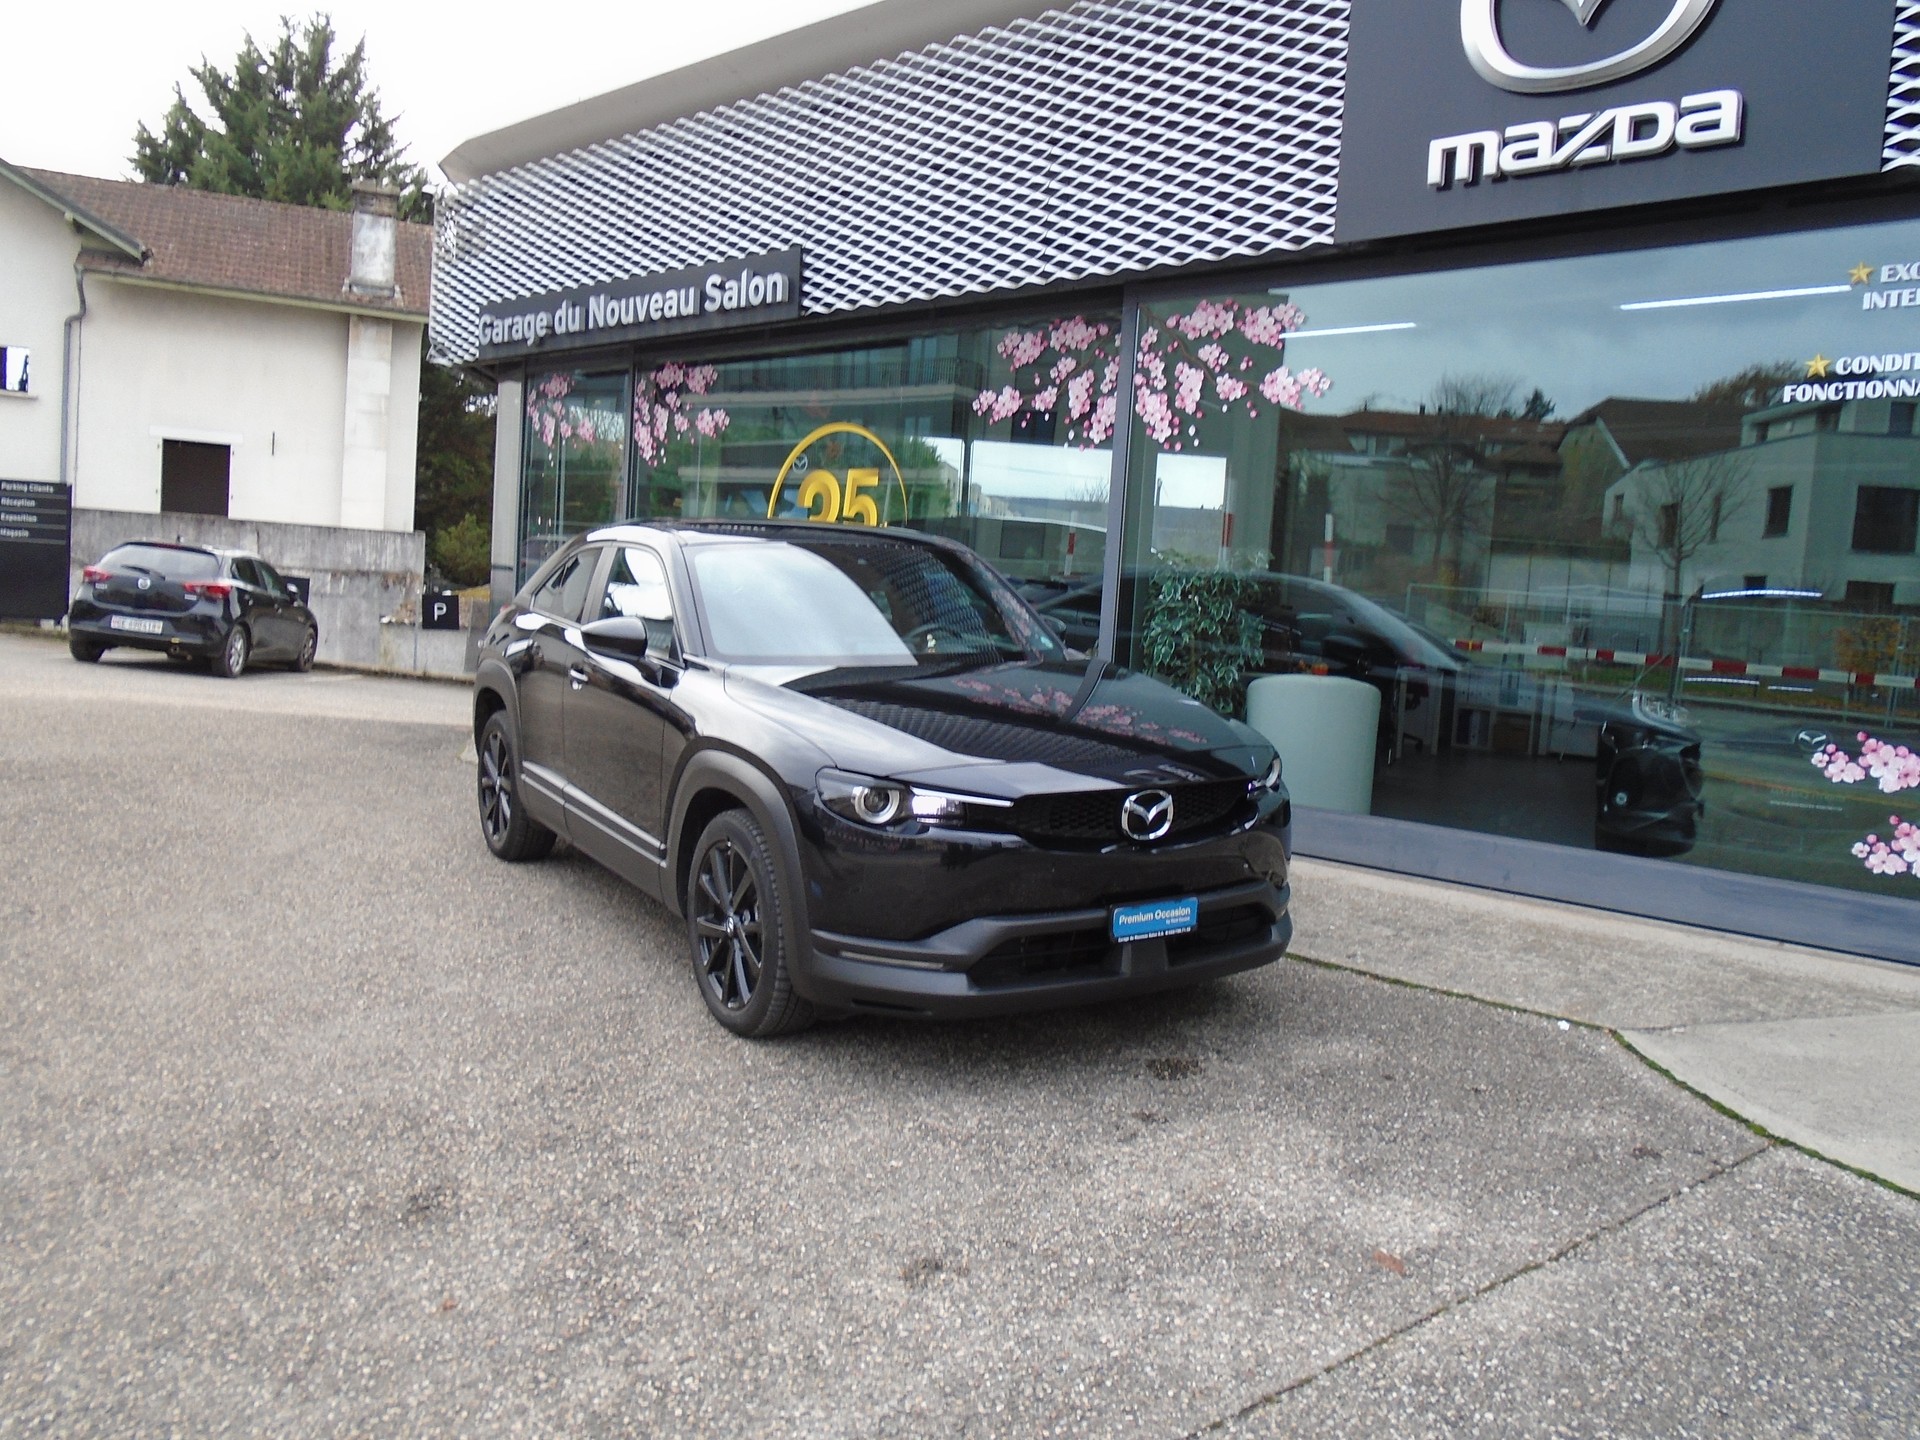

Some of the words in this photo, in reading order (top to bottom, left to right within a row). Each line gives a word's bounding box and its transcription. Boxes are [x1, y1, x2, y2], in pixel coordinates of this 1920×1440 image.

[477, 310, 551, 347] Garage
[554, 298, 584, 335] du
[588, 285, 698, 331] Nouveau
[703, 268, 790, 313] Salon
[1862, 286, 1920, 311] INTE
[1, 481, 28, 493] Parking
[433, 602, 447, 621] P
[1119, 911, 1154, 926] Premium
[1154, 905, 1191, 920] Occasion
